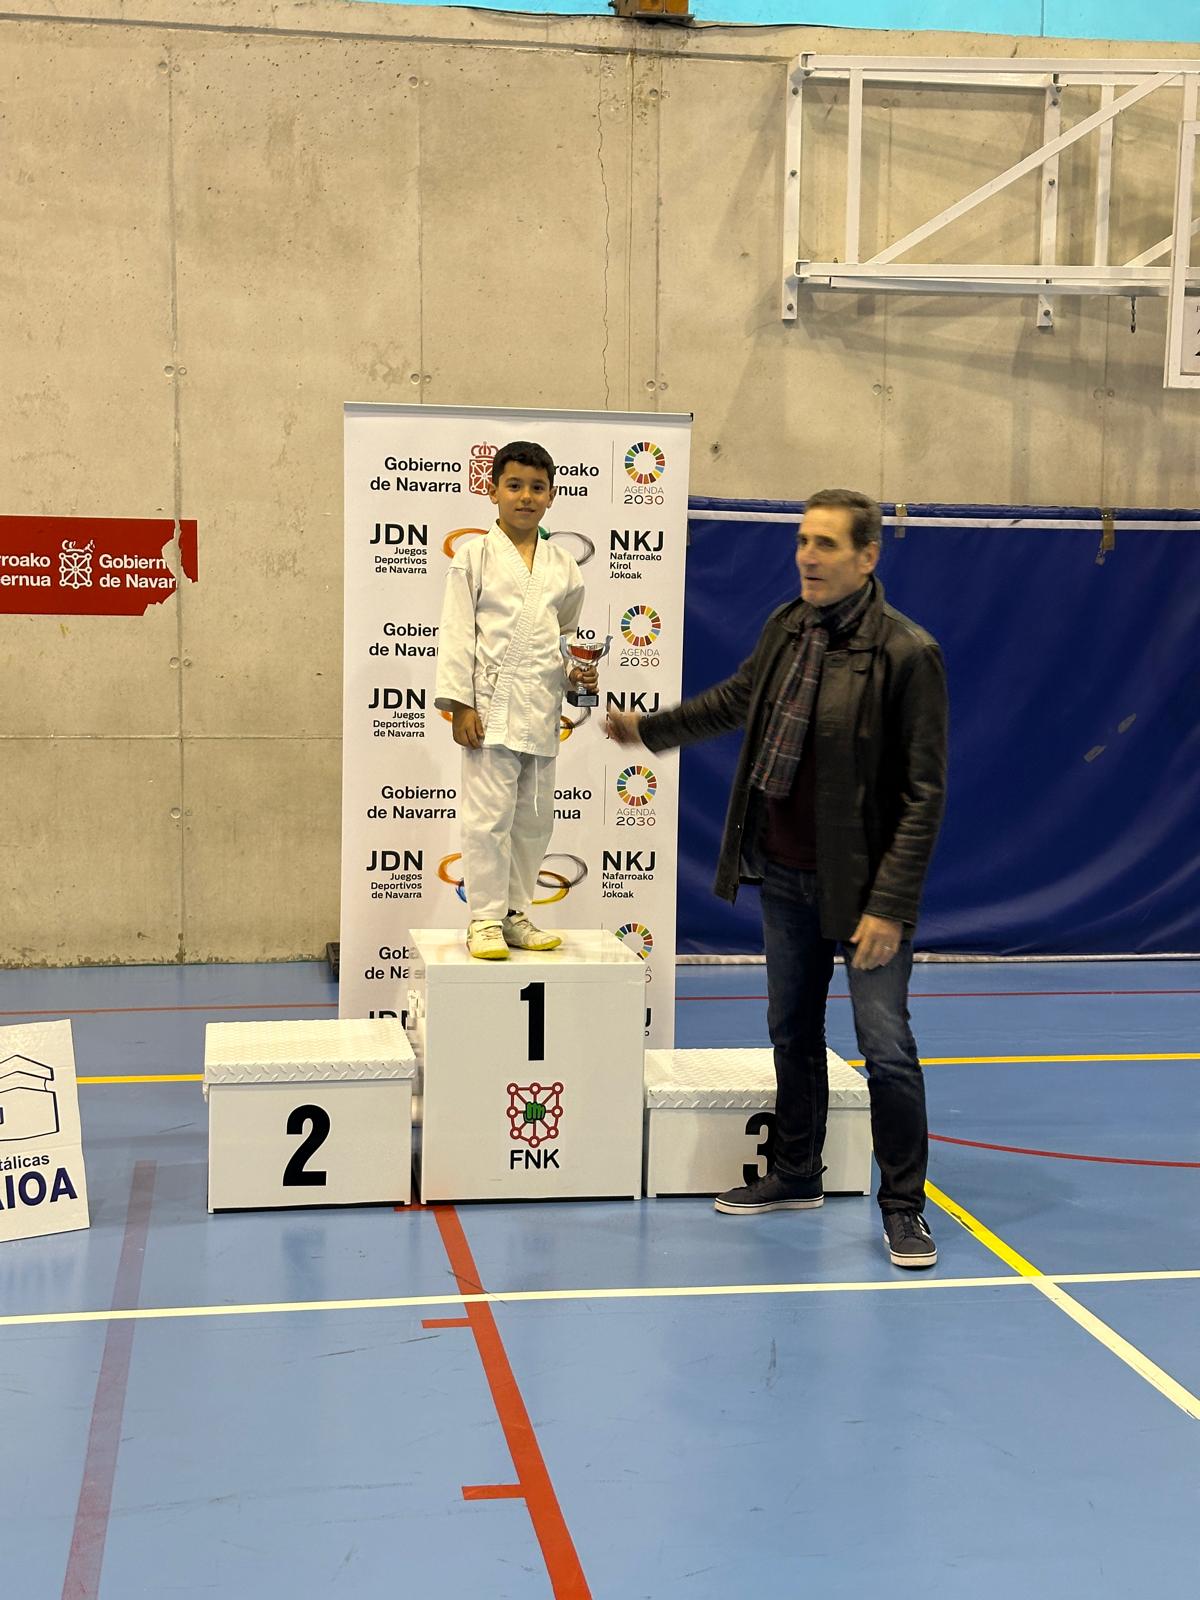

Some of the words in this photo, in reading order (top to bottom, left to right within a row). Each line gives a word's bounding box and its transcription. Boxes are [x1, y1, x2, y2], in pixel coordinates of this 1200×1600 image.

[385, 457, 461, 472] Gobierno
[554, 462, 600, 477] roako
[370, 477, 390, 490] de
[397, 477, 461, 492] Navarra
[624, 486, 664, 494] AGENDA
[555, 485, 589, 498] nua
[624, 495, 664, 505] 2030
[370, 523, 427, 545] JDN
[611, 530, 663, 551] NKJ
[394, 547, 427, 556] Juegos
[610, 552, 661, 561] Nafarroako
[0, 552, 51, 568] roako
[99, 554, 167, 570] Gobiern
[375, 556, 427, 565] Deportivos
[376, 565, 387, 573] de
[390, 566, 427, 574] Navarra
[610, 571, 641, 579] Jokoak
[99, 574, 121, 588] de
[126, 574, 177, 588] Navar
[384, 623, 439, 636] Gobier
[369, 643, 389, 656] de
[395, 642, 439, 657] Nava
[620, 657, 659, 667] 2030
[369, 688, 425, 709] JDN
[606, 691, 660, 713] NKJ
[393, 711, 425, 720] Juegos
[373, 720, 425, 729] Deportivos
[374, 729, 385, 737] de
[382, 786, 456, 799] Gobierno
[367, 806, 387, 818] de
[393, 806, 456, 818] Navarra
[616, 808, 656, 816] AGENDA
[616, 817, 655, 826] 2030
[366, 851, 422, 871] JDN
[603, 851, 655, 871] NKJ
[390, 873, 422, 881] Juegos
[603, 872, 653, 880] Nafarroako
[371, 882, 422, 891] Deportivos
[602, 890, 633, 898] Jokoak
[364, 966, 385, 980] de
[520, 982, 544, 1061] 1
[283, 1105, 330, 1186] 2
[743, 1112, 776, 1186] 3
[510, 1149, 559, 1169] FNK
[0, 1167, 78, 1210] IOA
